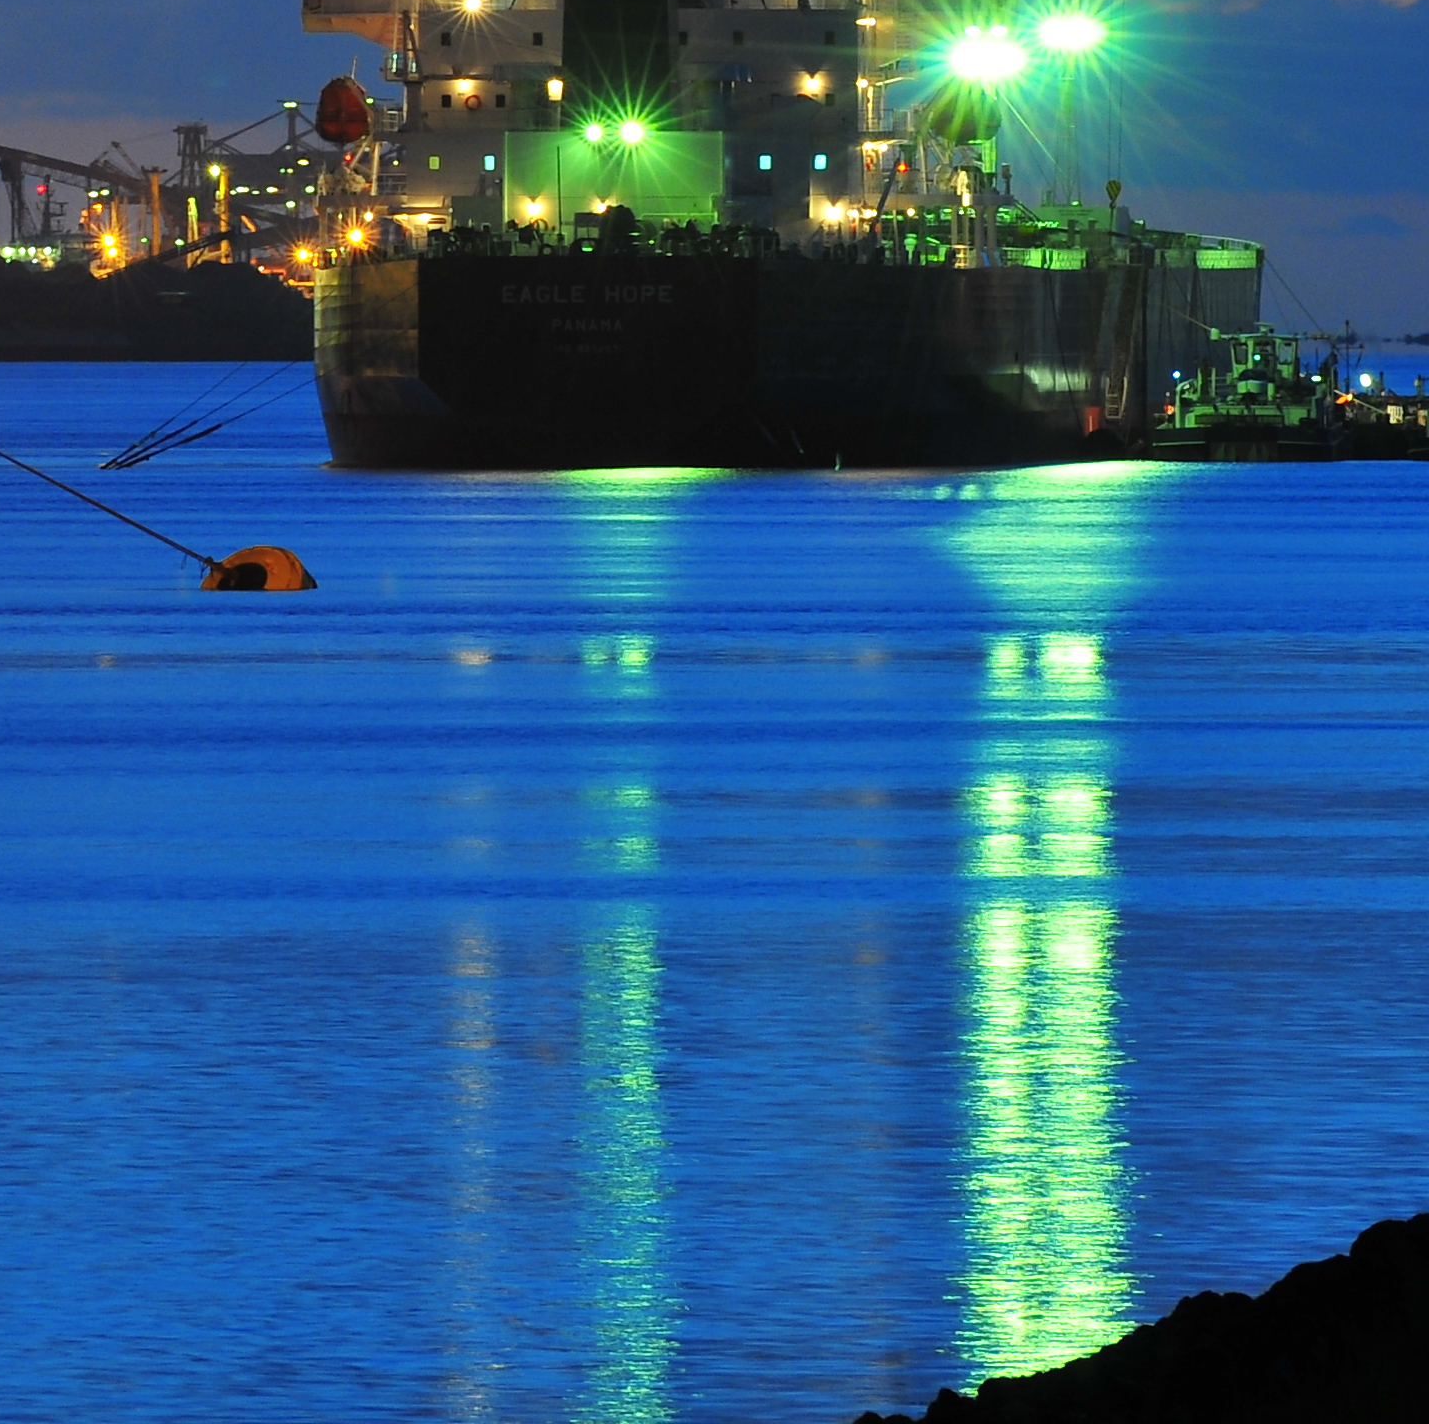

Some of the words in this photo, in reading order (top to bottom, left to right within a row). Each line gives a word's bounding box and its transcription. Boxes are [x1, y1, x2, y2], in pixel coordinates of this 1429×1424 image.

[501, 285, 586, 303] EAGLE
[604, 285, 674, 303] HOPE
[552, 319, 623, 331] PANAMA
